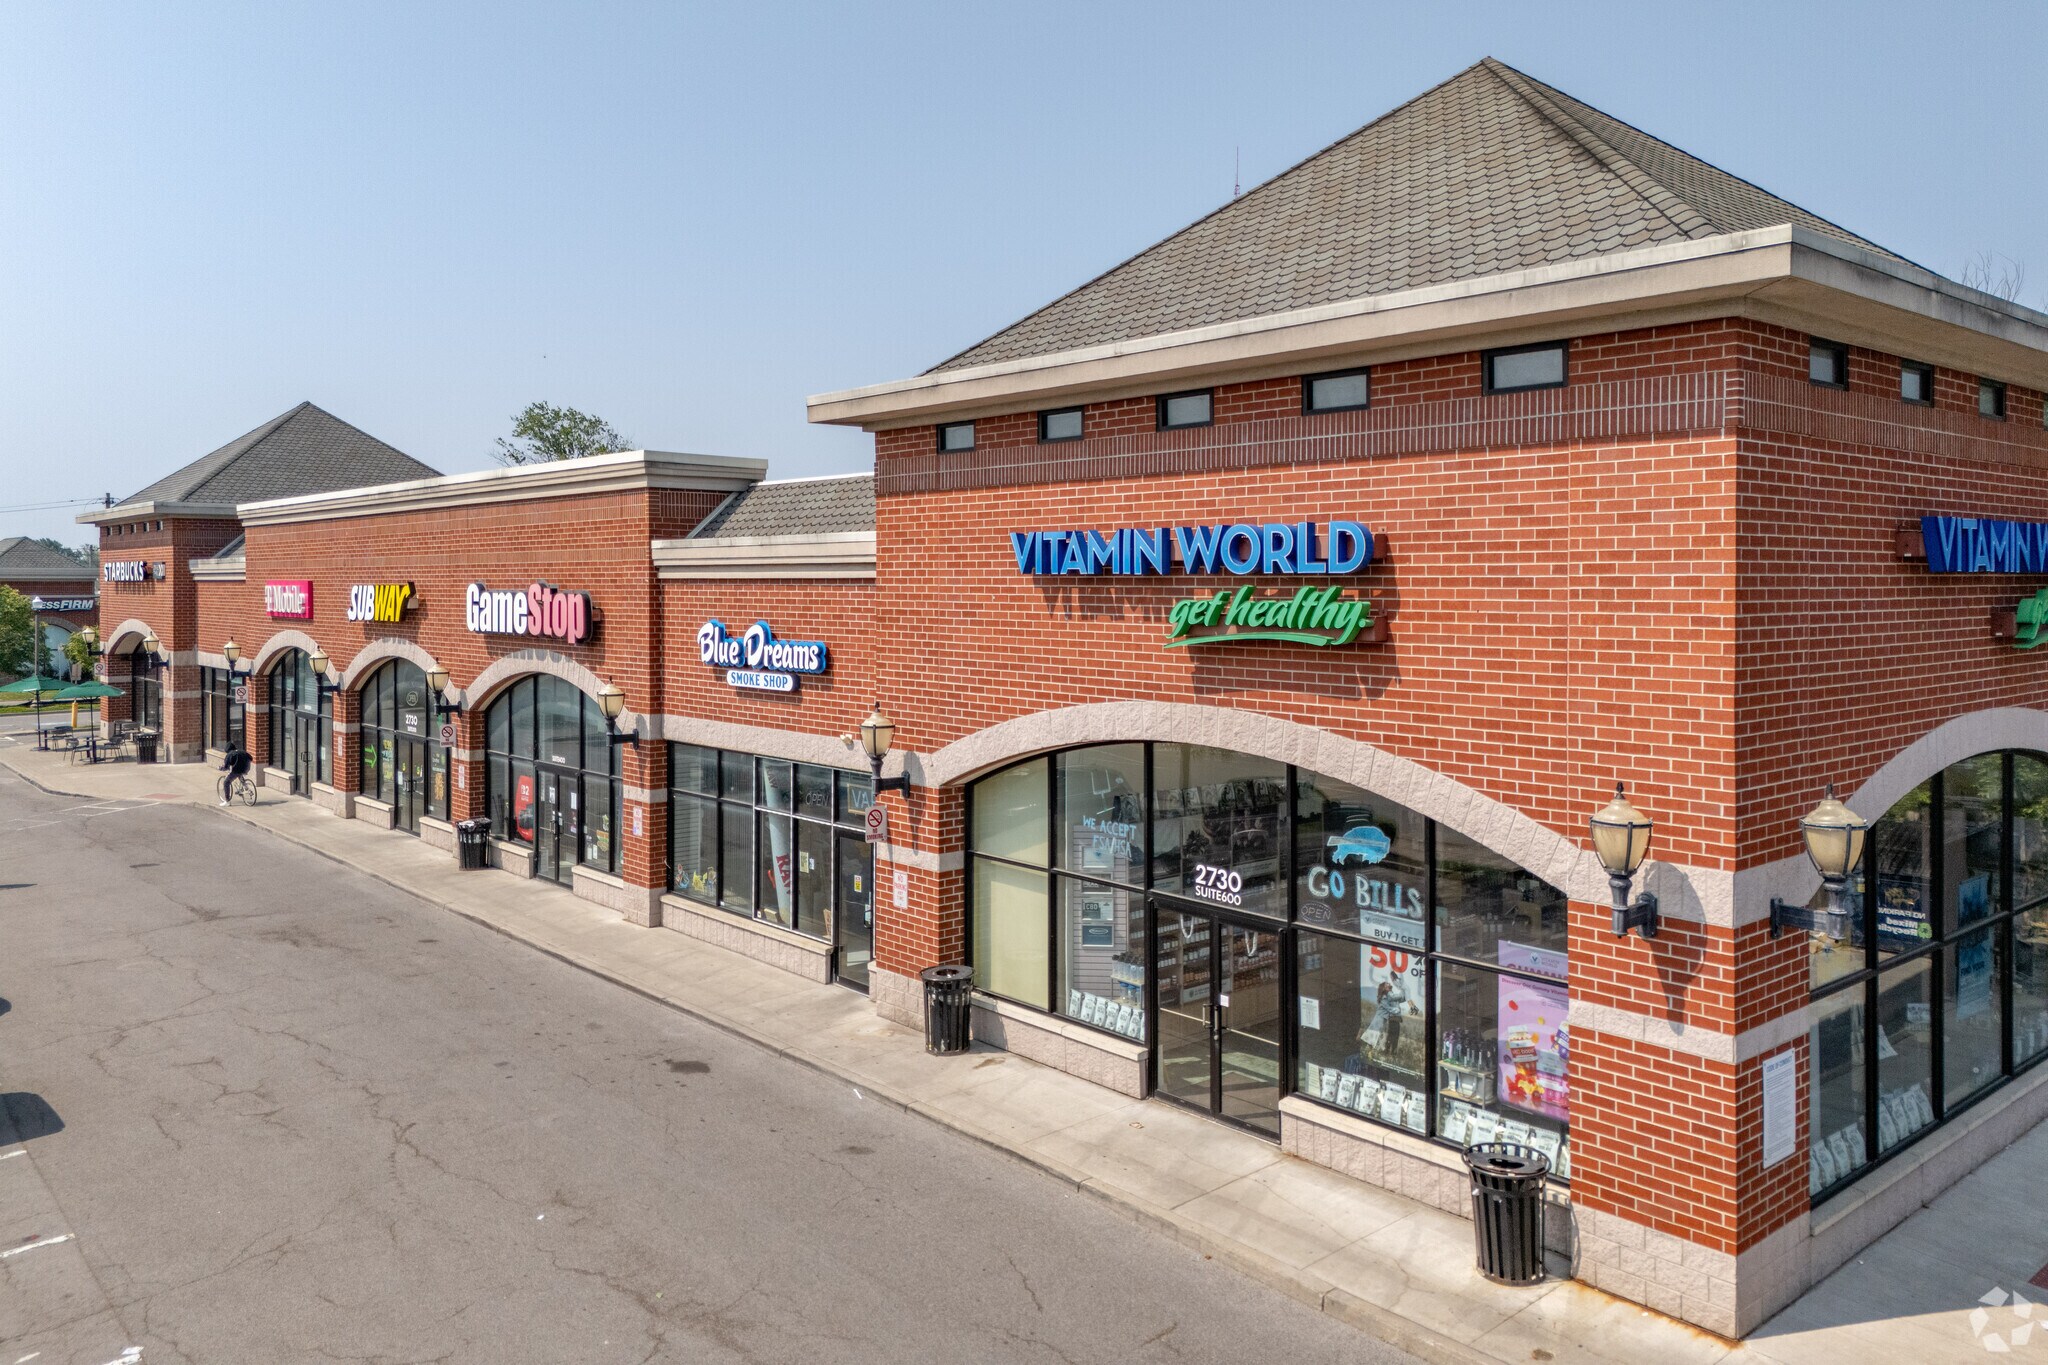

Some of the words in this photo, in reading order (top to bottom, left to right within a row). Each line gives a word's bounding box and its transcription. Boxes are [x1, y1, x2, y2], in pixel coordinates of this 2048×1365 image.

[1010, 526, 1165, 575] VITAMIN
[1176, 521, 1371, 575] WORLD
[1933, 516, 2031, 573] VITAMIN
[104, 561, 144, 581] STARBUCKS
[348, 584, 411, 622] SUBWAY
[466, 583, 585, 644] GameStop
[1165, 590, 1232, 640] get
[697, 622, 740, 665] Blue
[743, 624, 819, 671] Dreams
[731, 672, 761, 687] SMOKE
[763, 675, 788, 689] SHOP
[405, 714, 418, 726] 2730
[806, 791, 828, 806] OPEN
[852, 790, 874, 808] VA
[1083, 815, 1096, 830] WE
[1100, 820, 1137, 840] ACCEPT
[1195, 864, 1242, 893] 2730
[1308, 866, 1345, 899] GO
[1355, 873, 1423, 919] BILLS
[1301, 905, 1331, 921] OPEN
[1374, 929, 1393, 940] BUY
[1401, 935, 1420, 946] GET
[1410, 968, 1426, 979] OF
